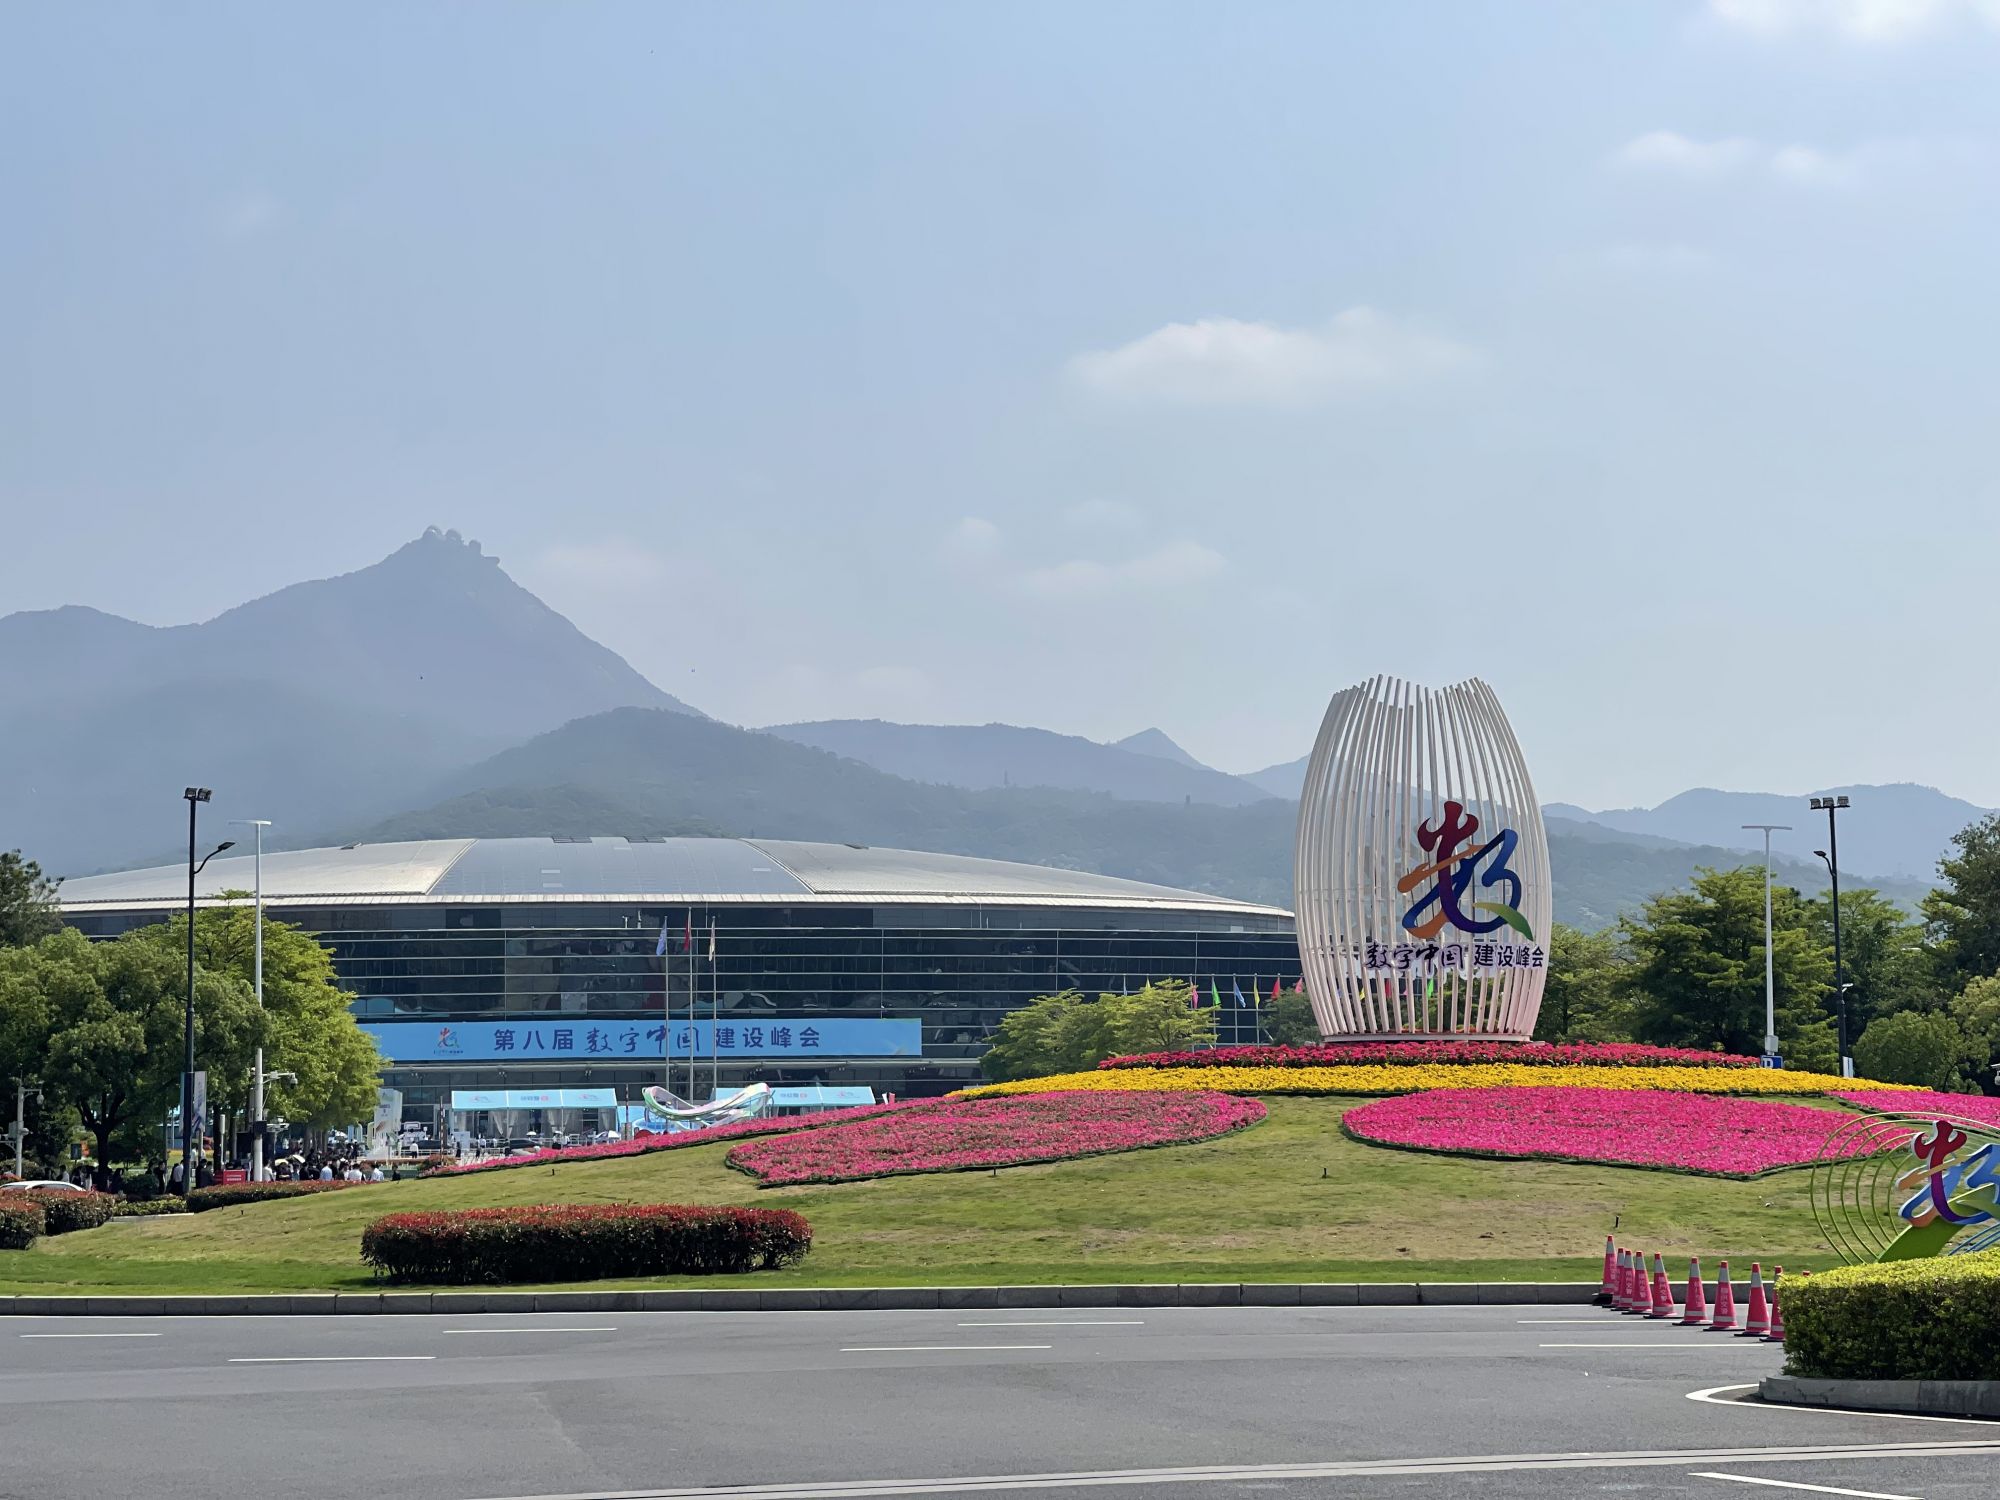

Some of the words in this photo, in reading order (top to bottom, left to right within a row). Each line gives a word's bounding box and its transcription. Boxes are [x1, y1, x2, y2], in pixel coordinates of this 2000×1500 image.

[1365, 941, 1544, 973] 数字中国建设峰会
[493, 1024, 820, 1053] 第八届数字中国建设峰会
